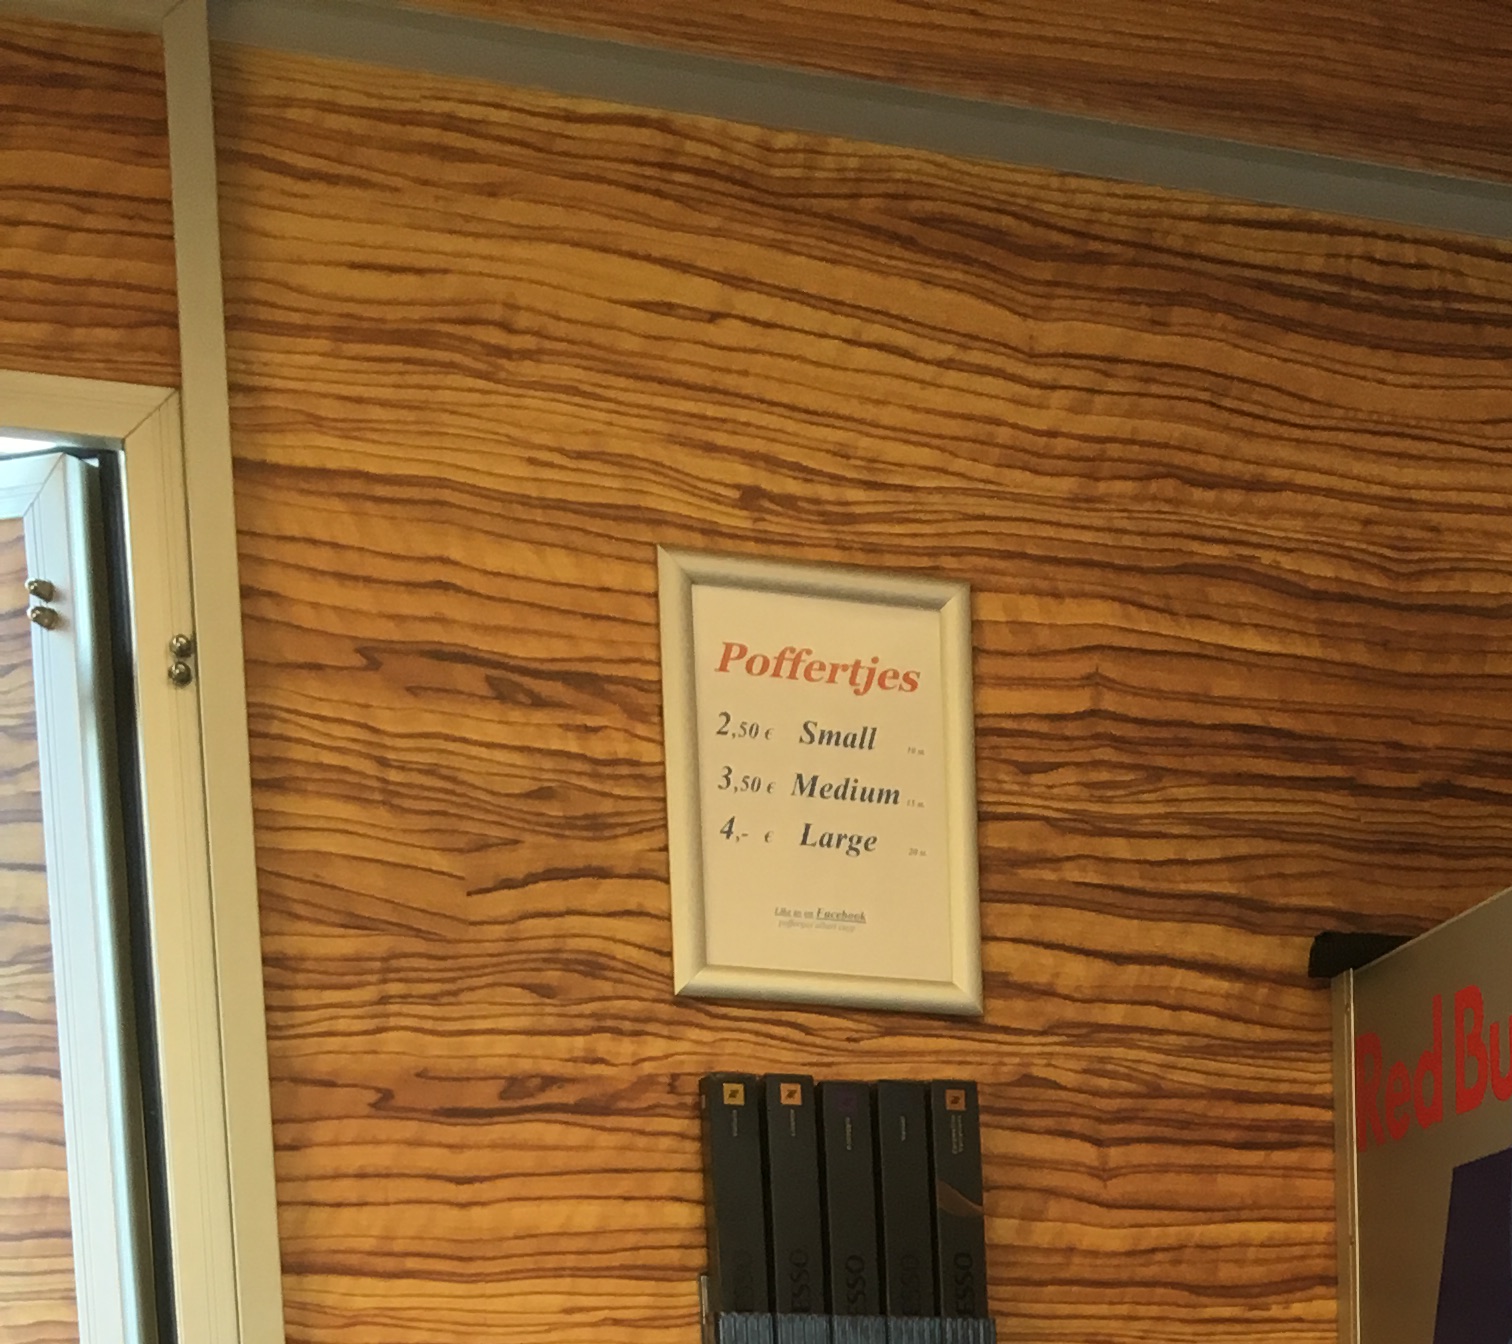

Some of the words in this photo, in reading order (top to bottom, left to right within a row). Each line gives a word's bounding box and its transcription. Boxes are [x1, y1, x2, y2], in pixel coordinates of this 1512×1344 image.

[715, 641, 921, 696] Poffertjes
[716, 711, 760, 740] 2,50
[799, 720, 877, 750] Small
[718, 765, 762, 793] 3,50
[791, 772, 900, 805] Medium
[800, 822, 877, 858] Large
[1356, 994, 1444, 1153] Red
